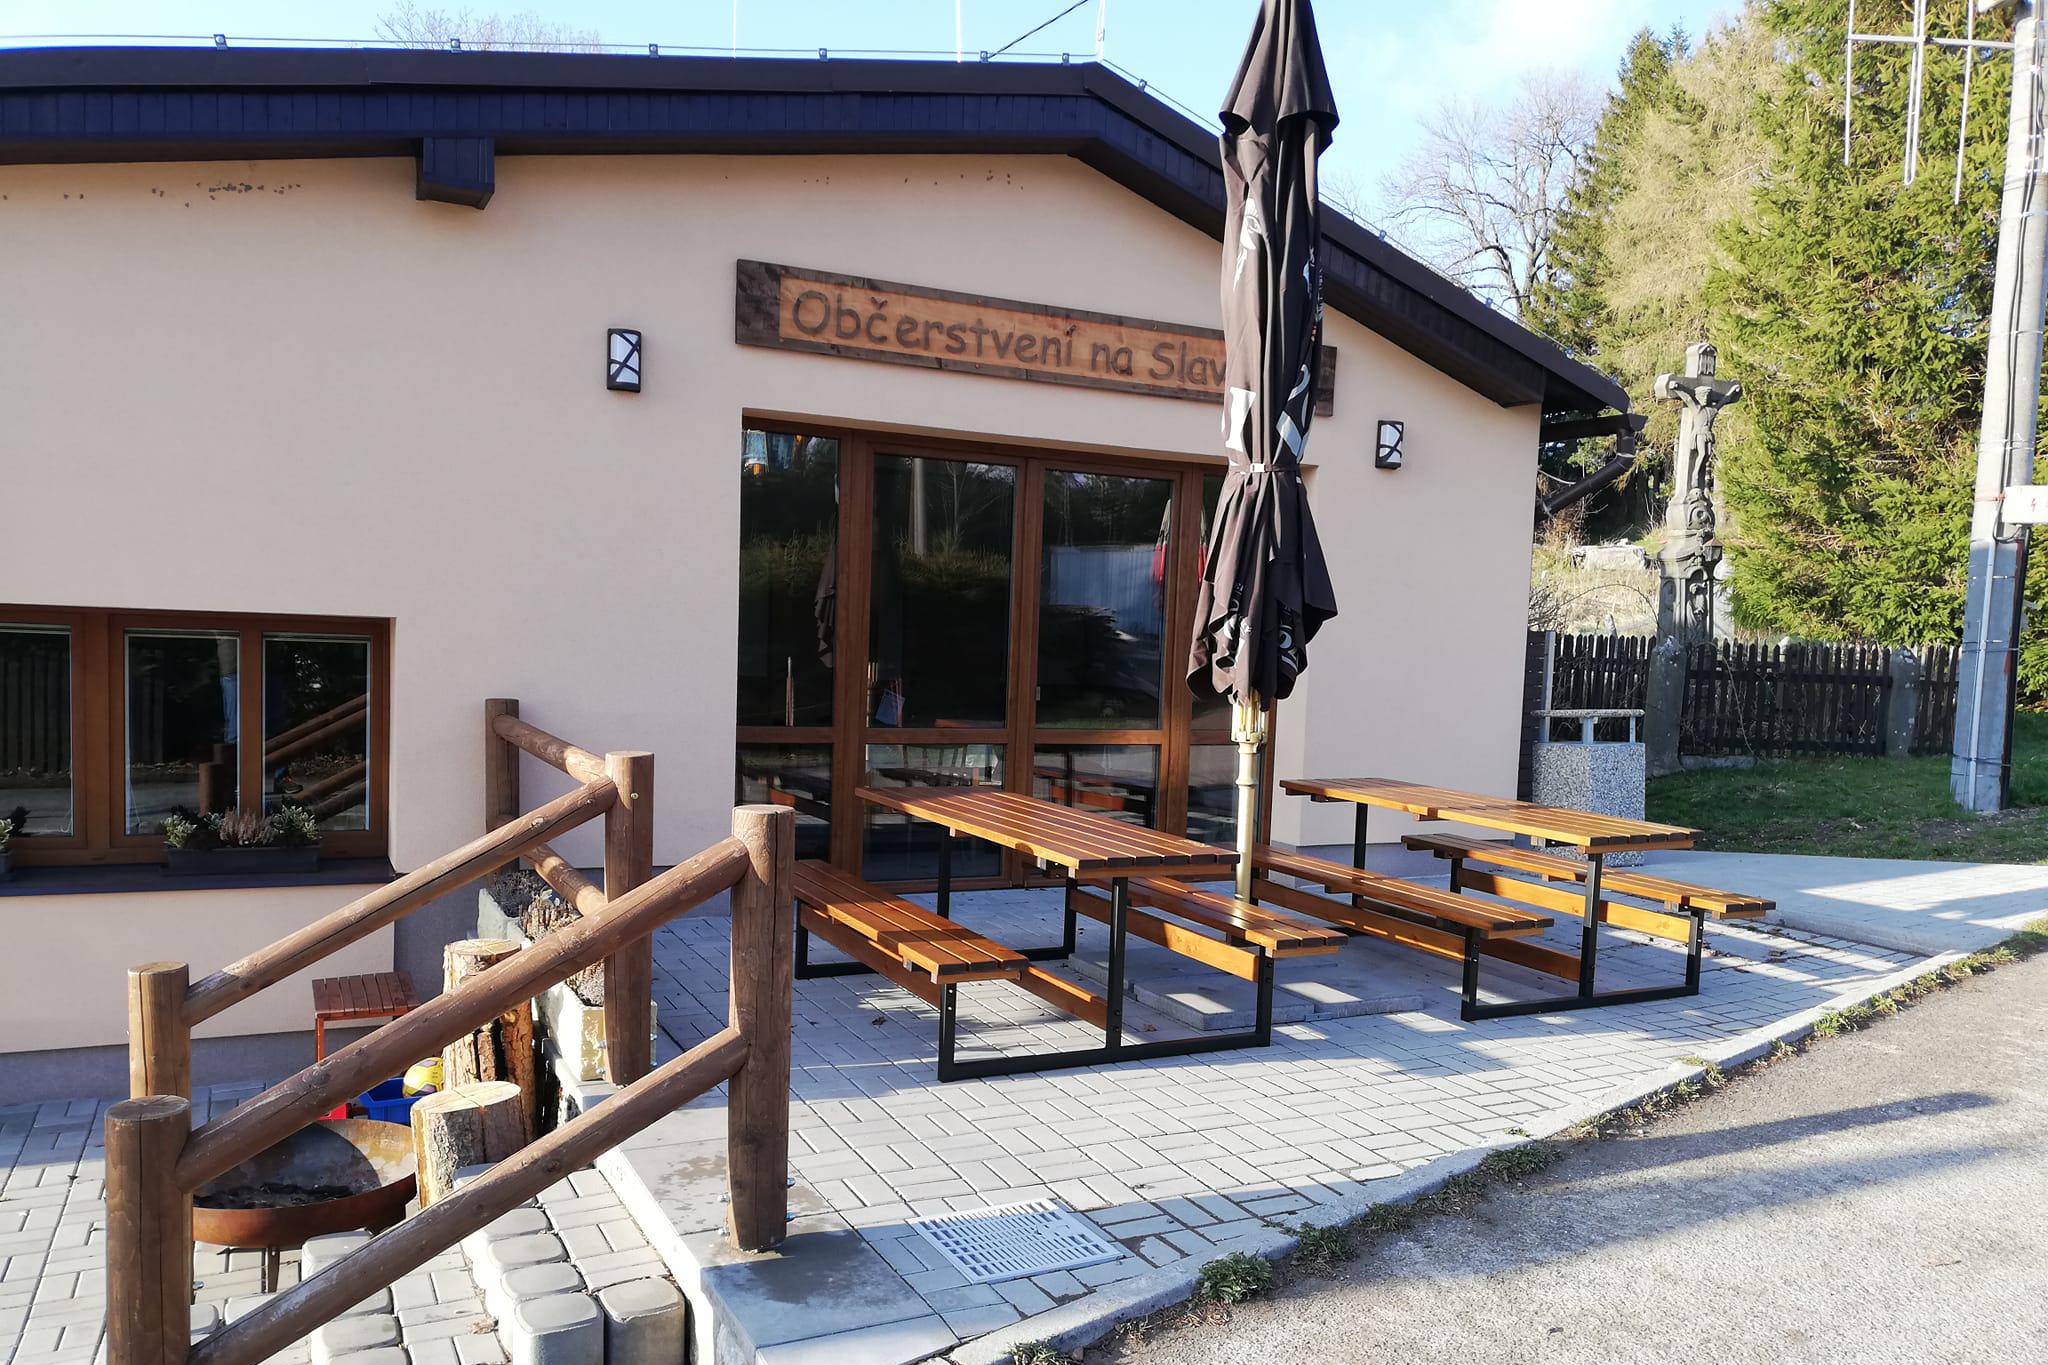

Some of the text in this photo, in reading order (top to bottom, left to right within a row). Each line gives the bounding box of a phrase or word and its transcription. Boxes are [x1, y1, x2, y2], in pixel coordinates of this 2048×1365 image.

[793, 290, 1226, 387] Občerstvení na Slav
